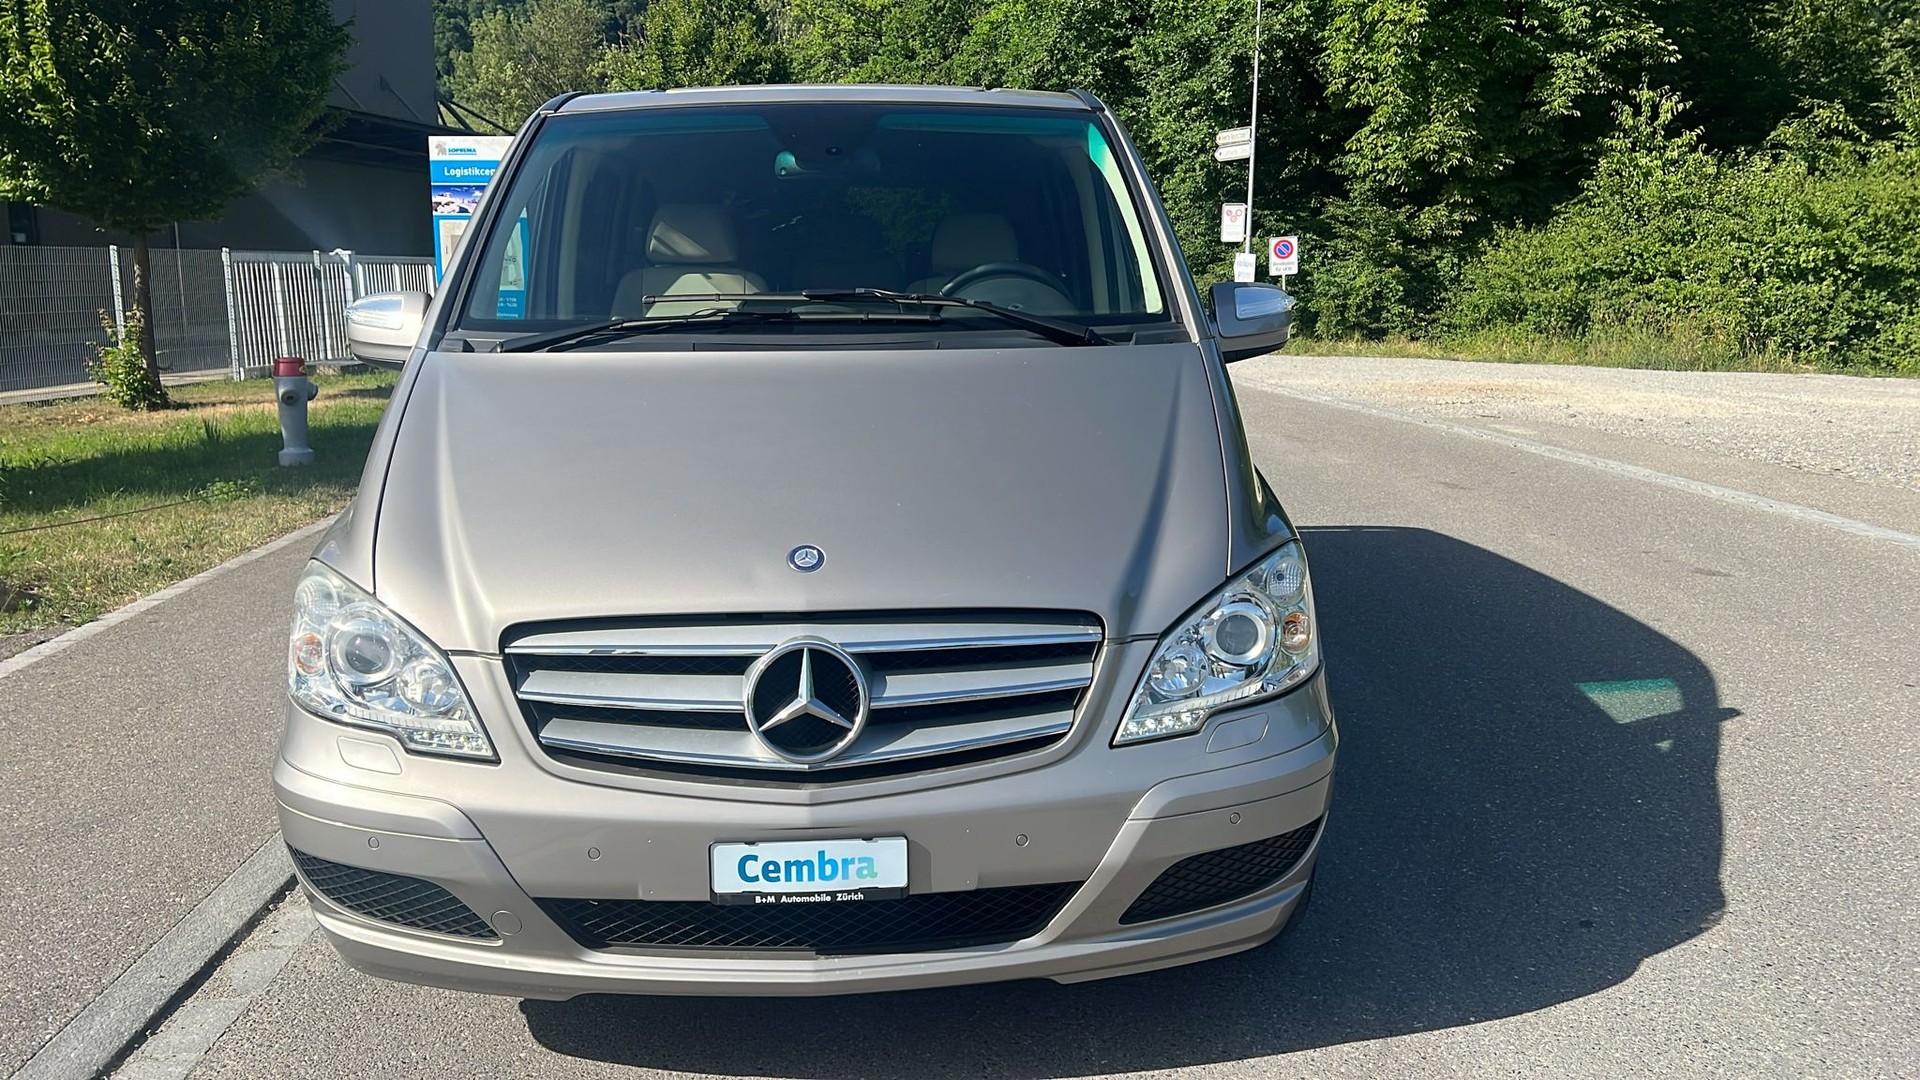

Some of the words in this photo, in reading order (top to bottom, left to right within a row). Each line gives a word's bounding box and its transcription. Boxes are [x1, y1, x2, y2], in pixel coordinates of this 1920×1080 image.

[737, 850, 878, 883] Cembra
[755, 895, 776, 904] B+M
[780, 893, 832, 903] Automobile
[836, 891, 864, 902] Zürich
